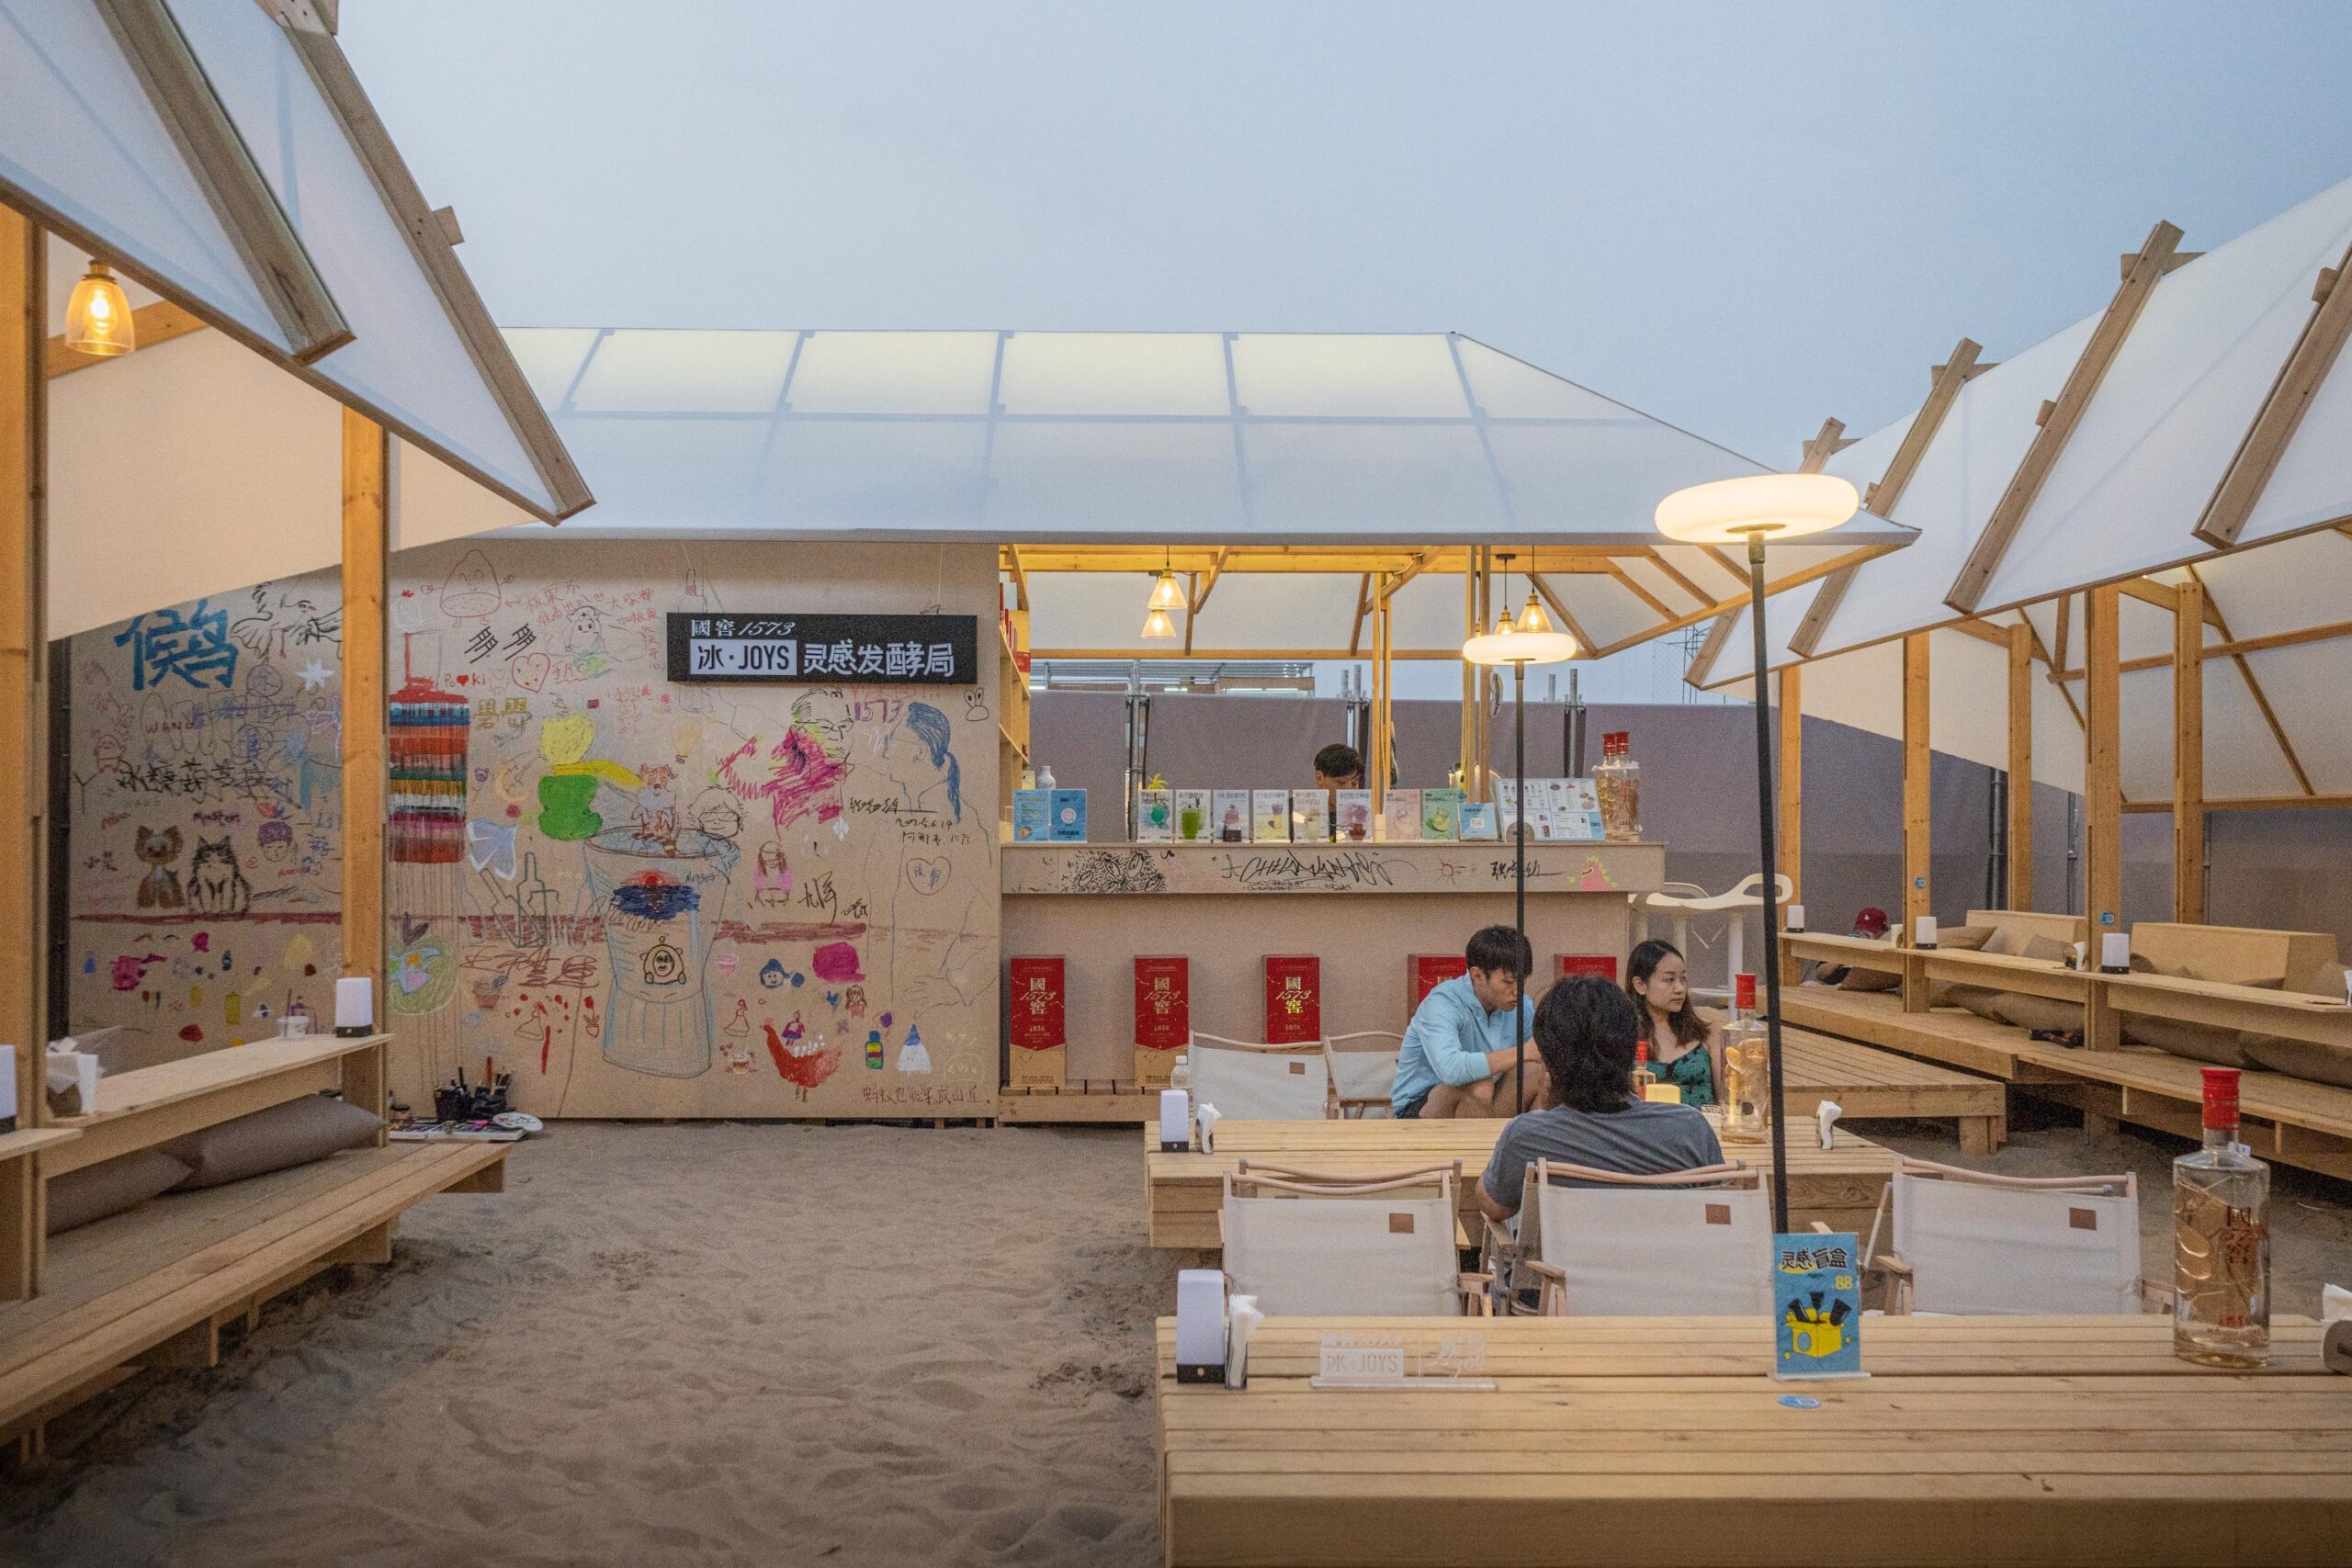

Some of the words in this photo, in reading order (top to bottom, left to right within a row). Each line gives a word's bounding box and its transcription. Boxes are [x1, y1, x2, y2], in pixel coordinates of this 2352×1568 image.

[802, 638, 956, 678] 灵感发酵局
[854, 698, 903, 724] 1573
[1781, 1247, 1849, 1269] 灵感盲盒
